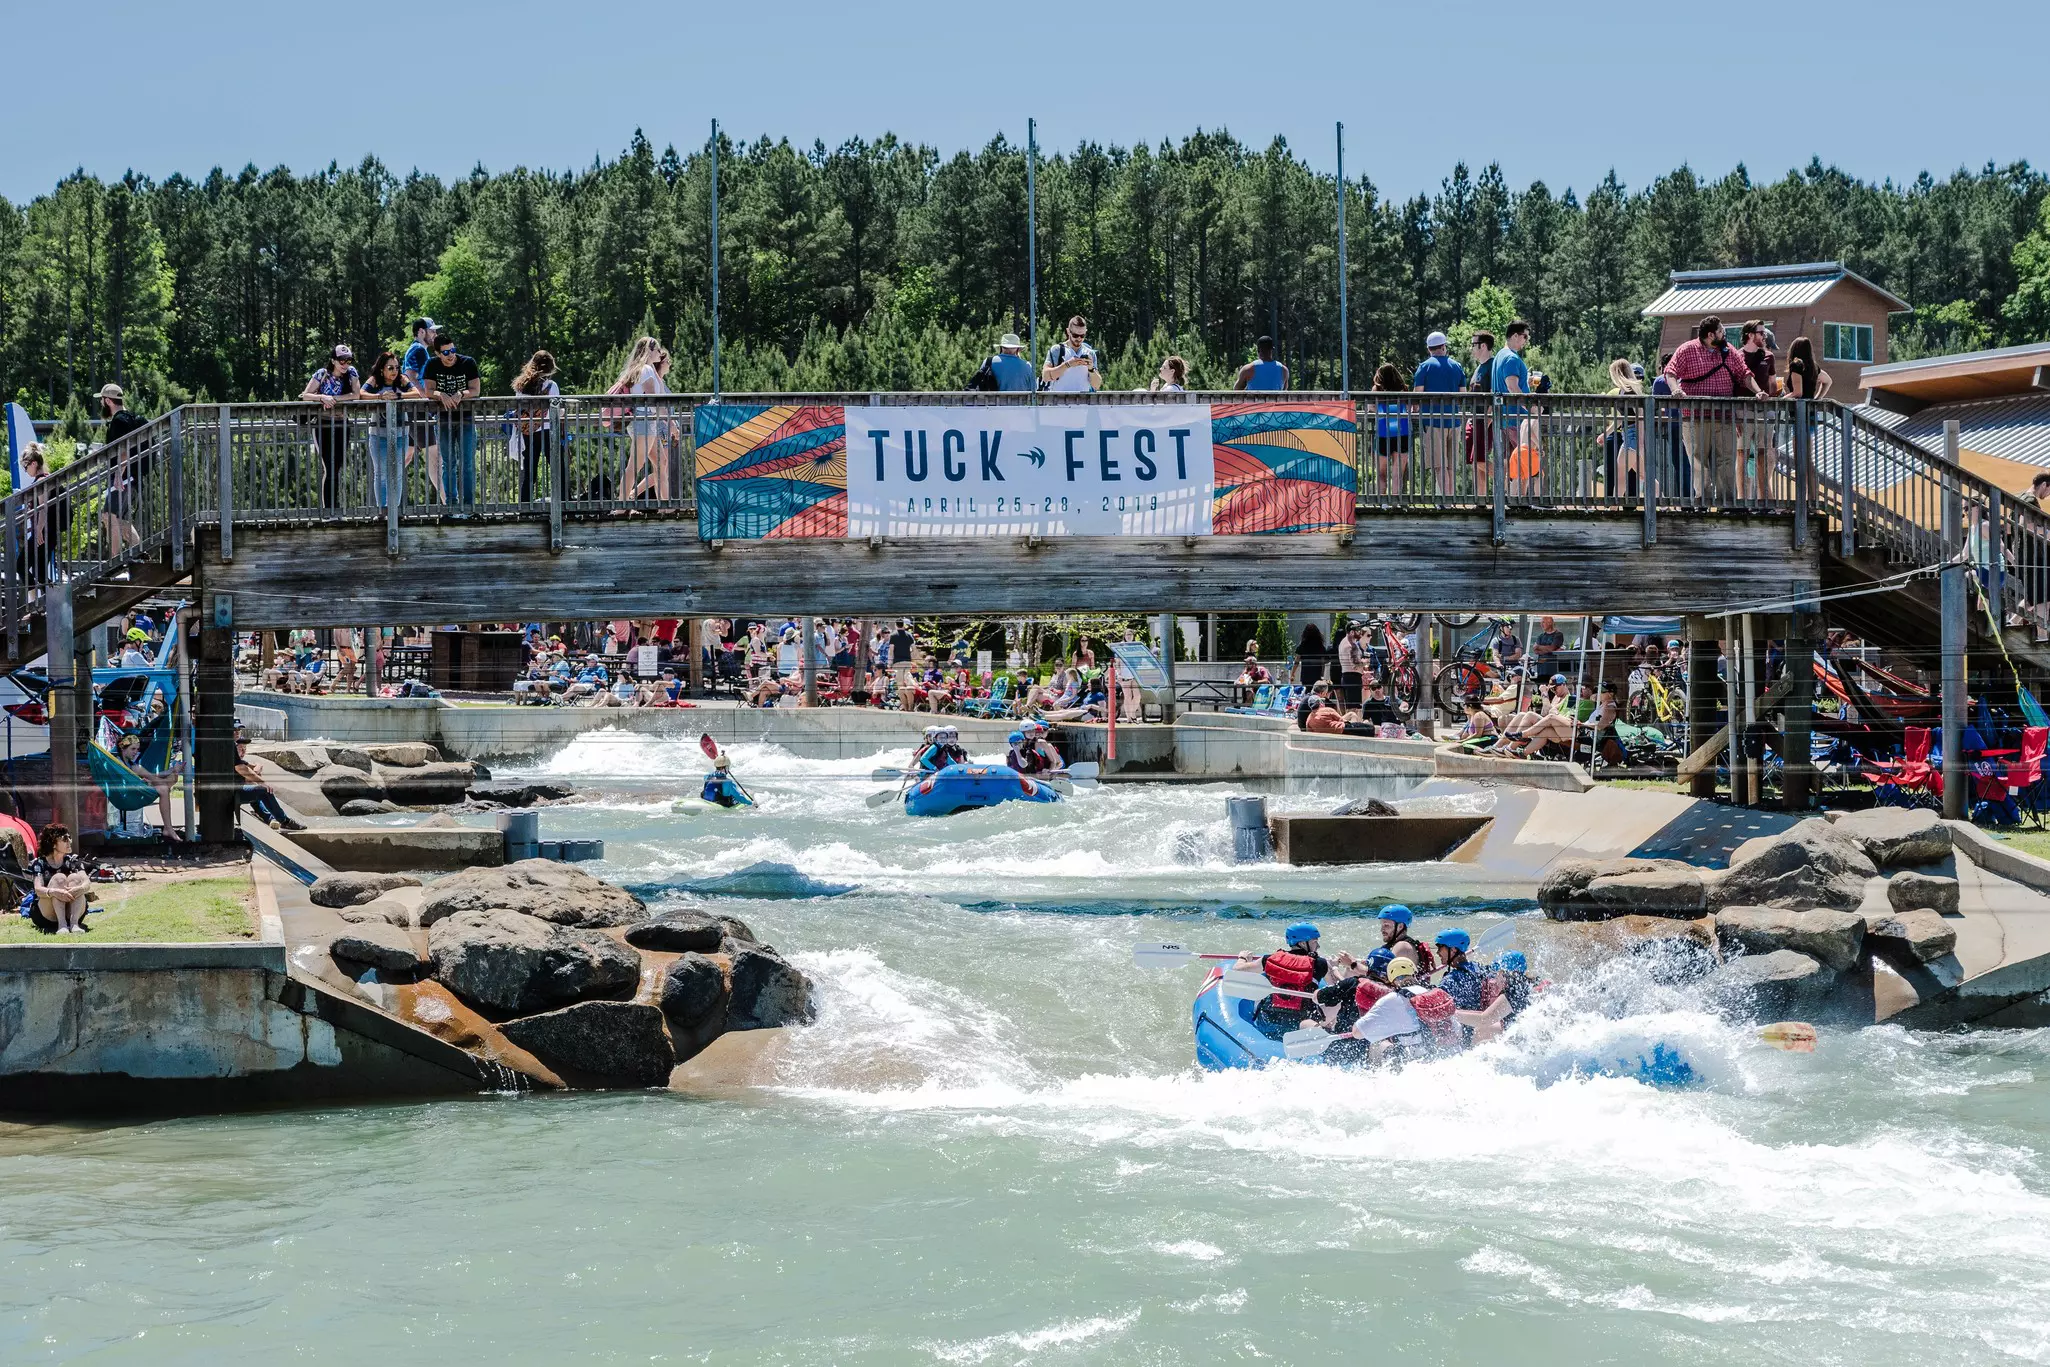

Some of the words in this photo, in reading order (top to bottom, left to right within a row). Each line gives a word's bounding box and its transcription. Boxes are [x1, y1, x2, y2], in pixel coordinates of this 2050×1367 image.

[867, 429, 1006, 482] TUCK
[1064, 428, 1191, 482] FEST
[907, 496, 977, 513] APRIL
[997, 496, 1081, 514] 25-28,
[1102, 495, 1158, 512] 2019
